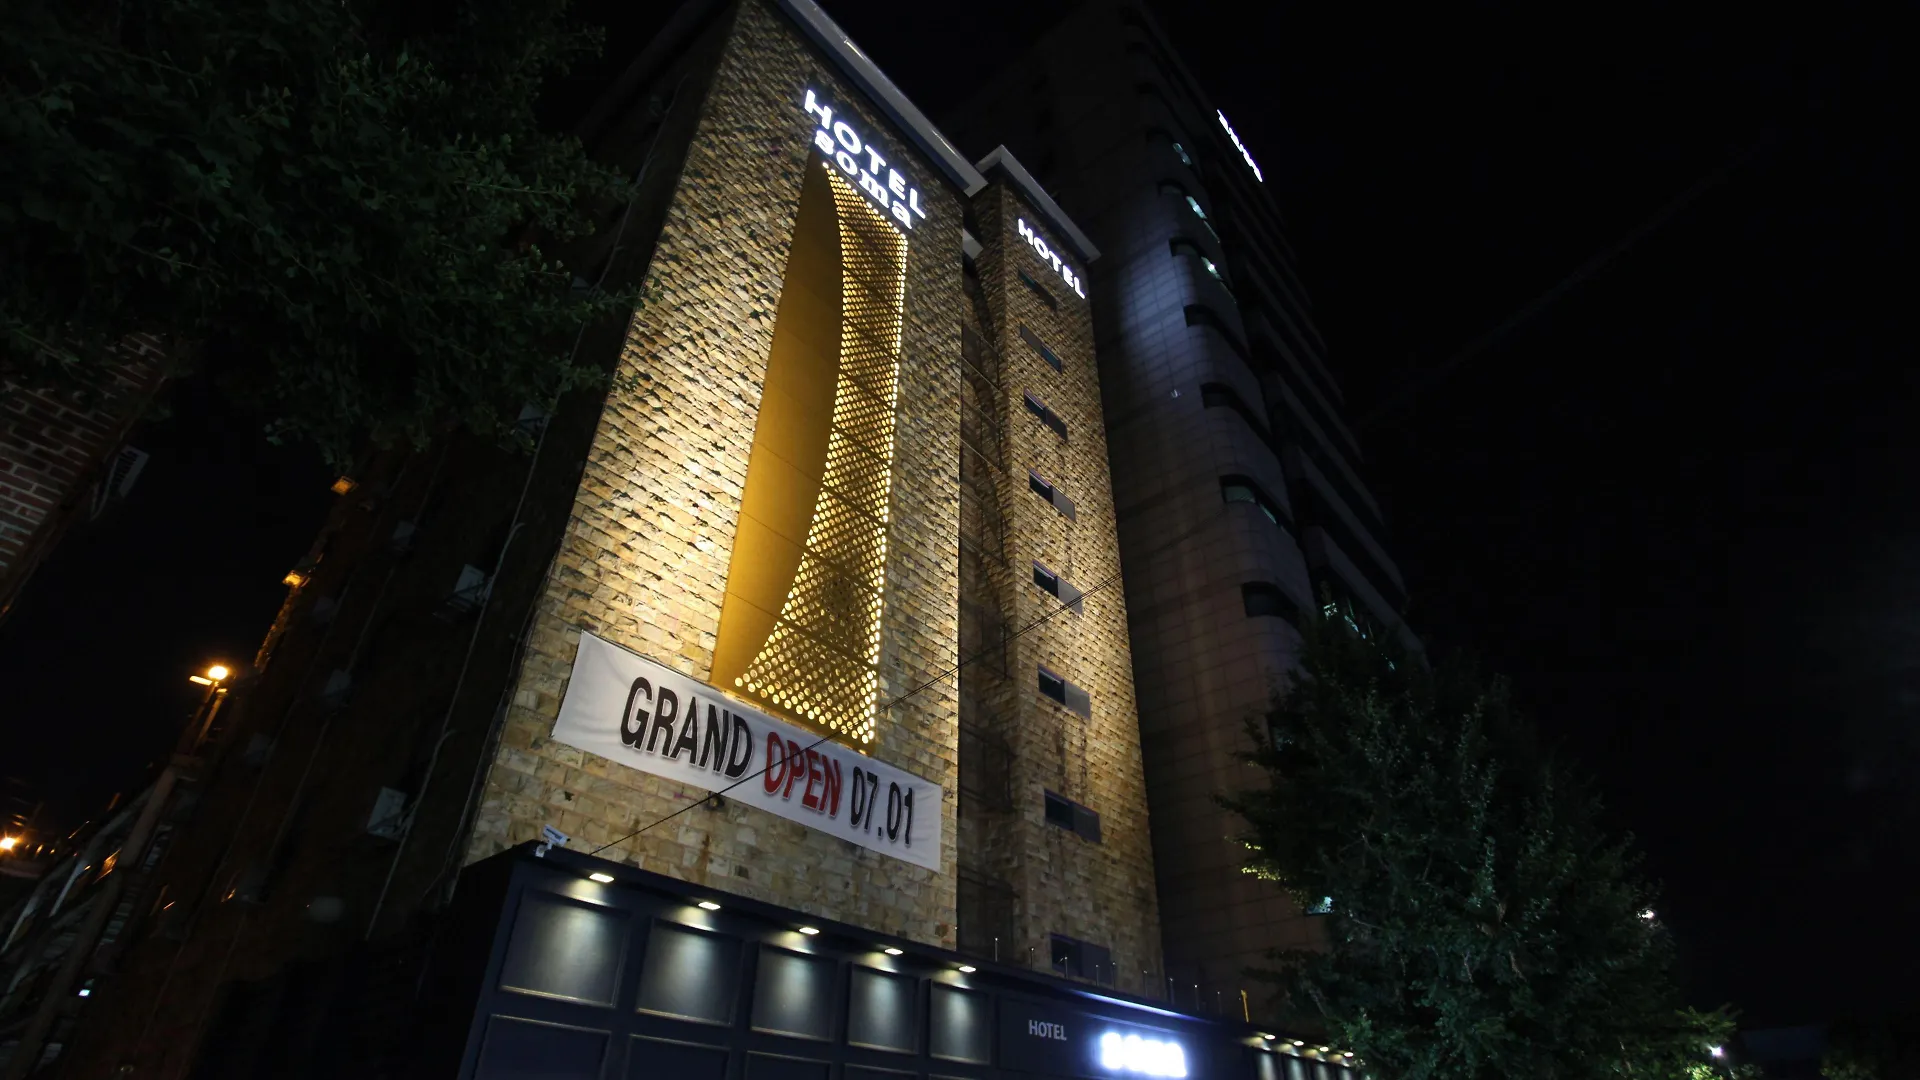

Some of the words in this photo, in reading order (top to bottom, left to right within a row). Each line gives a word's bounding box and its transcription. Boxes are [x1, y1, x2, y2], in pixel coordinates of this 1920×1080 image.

[805, 89, 926, 219] HOTEL
[814, 130, 913, 230] soma
[1018, 218, 1085, 299] HOTEL
[620, 676, 753, 779] GRAND
[763, 731, 842, 817] OPEN
[850, 765, 915, 847] 07.01
[1028, 1019, 1067, 1041] HOTEL
